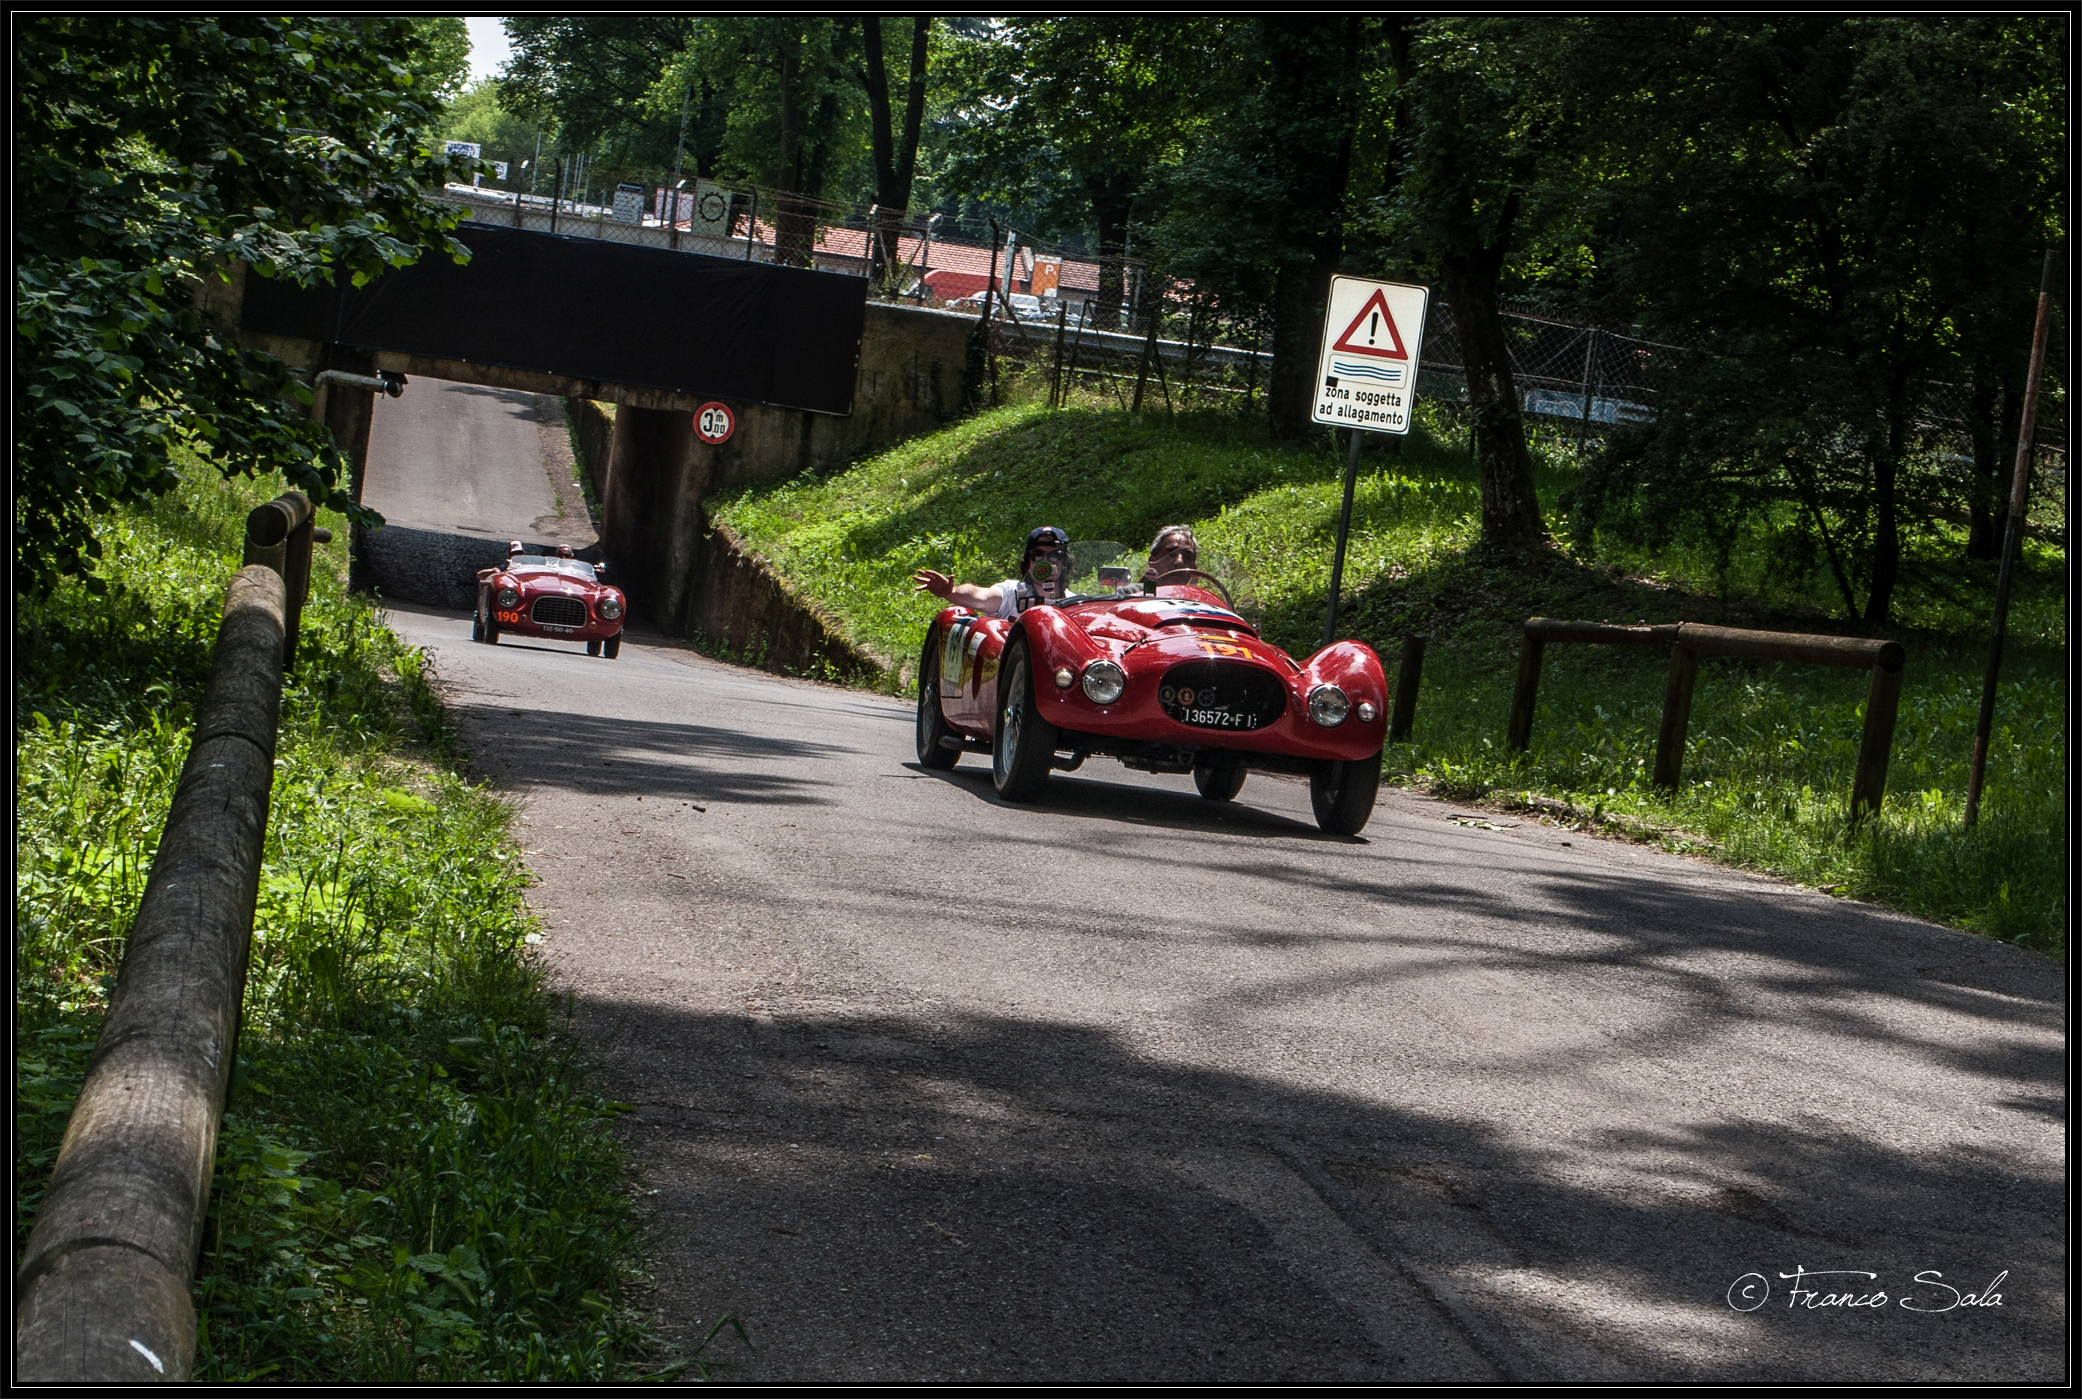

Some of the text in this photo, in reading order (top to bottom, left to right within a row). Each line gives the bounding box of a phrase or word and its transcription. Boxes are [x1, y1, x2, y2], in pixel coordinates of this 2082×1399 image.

[1325, 386, 1402, 407] zona soggetta
[1319, 402, 1404, 425] ad allagamento
[497, 611, 519, 623] 190
[1199, 643, 1254, 659] 191
[1184, 708, 1230, 726] 136572
